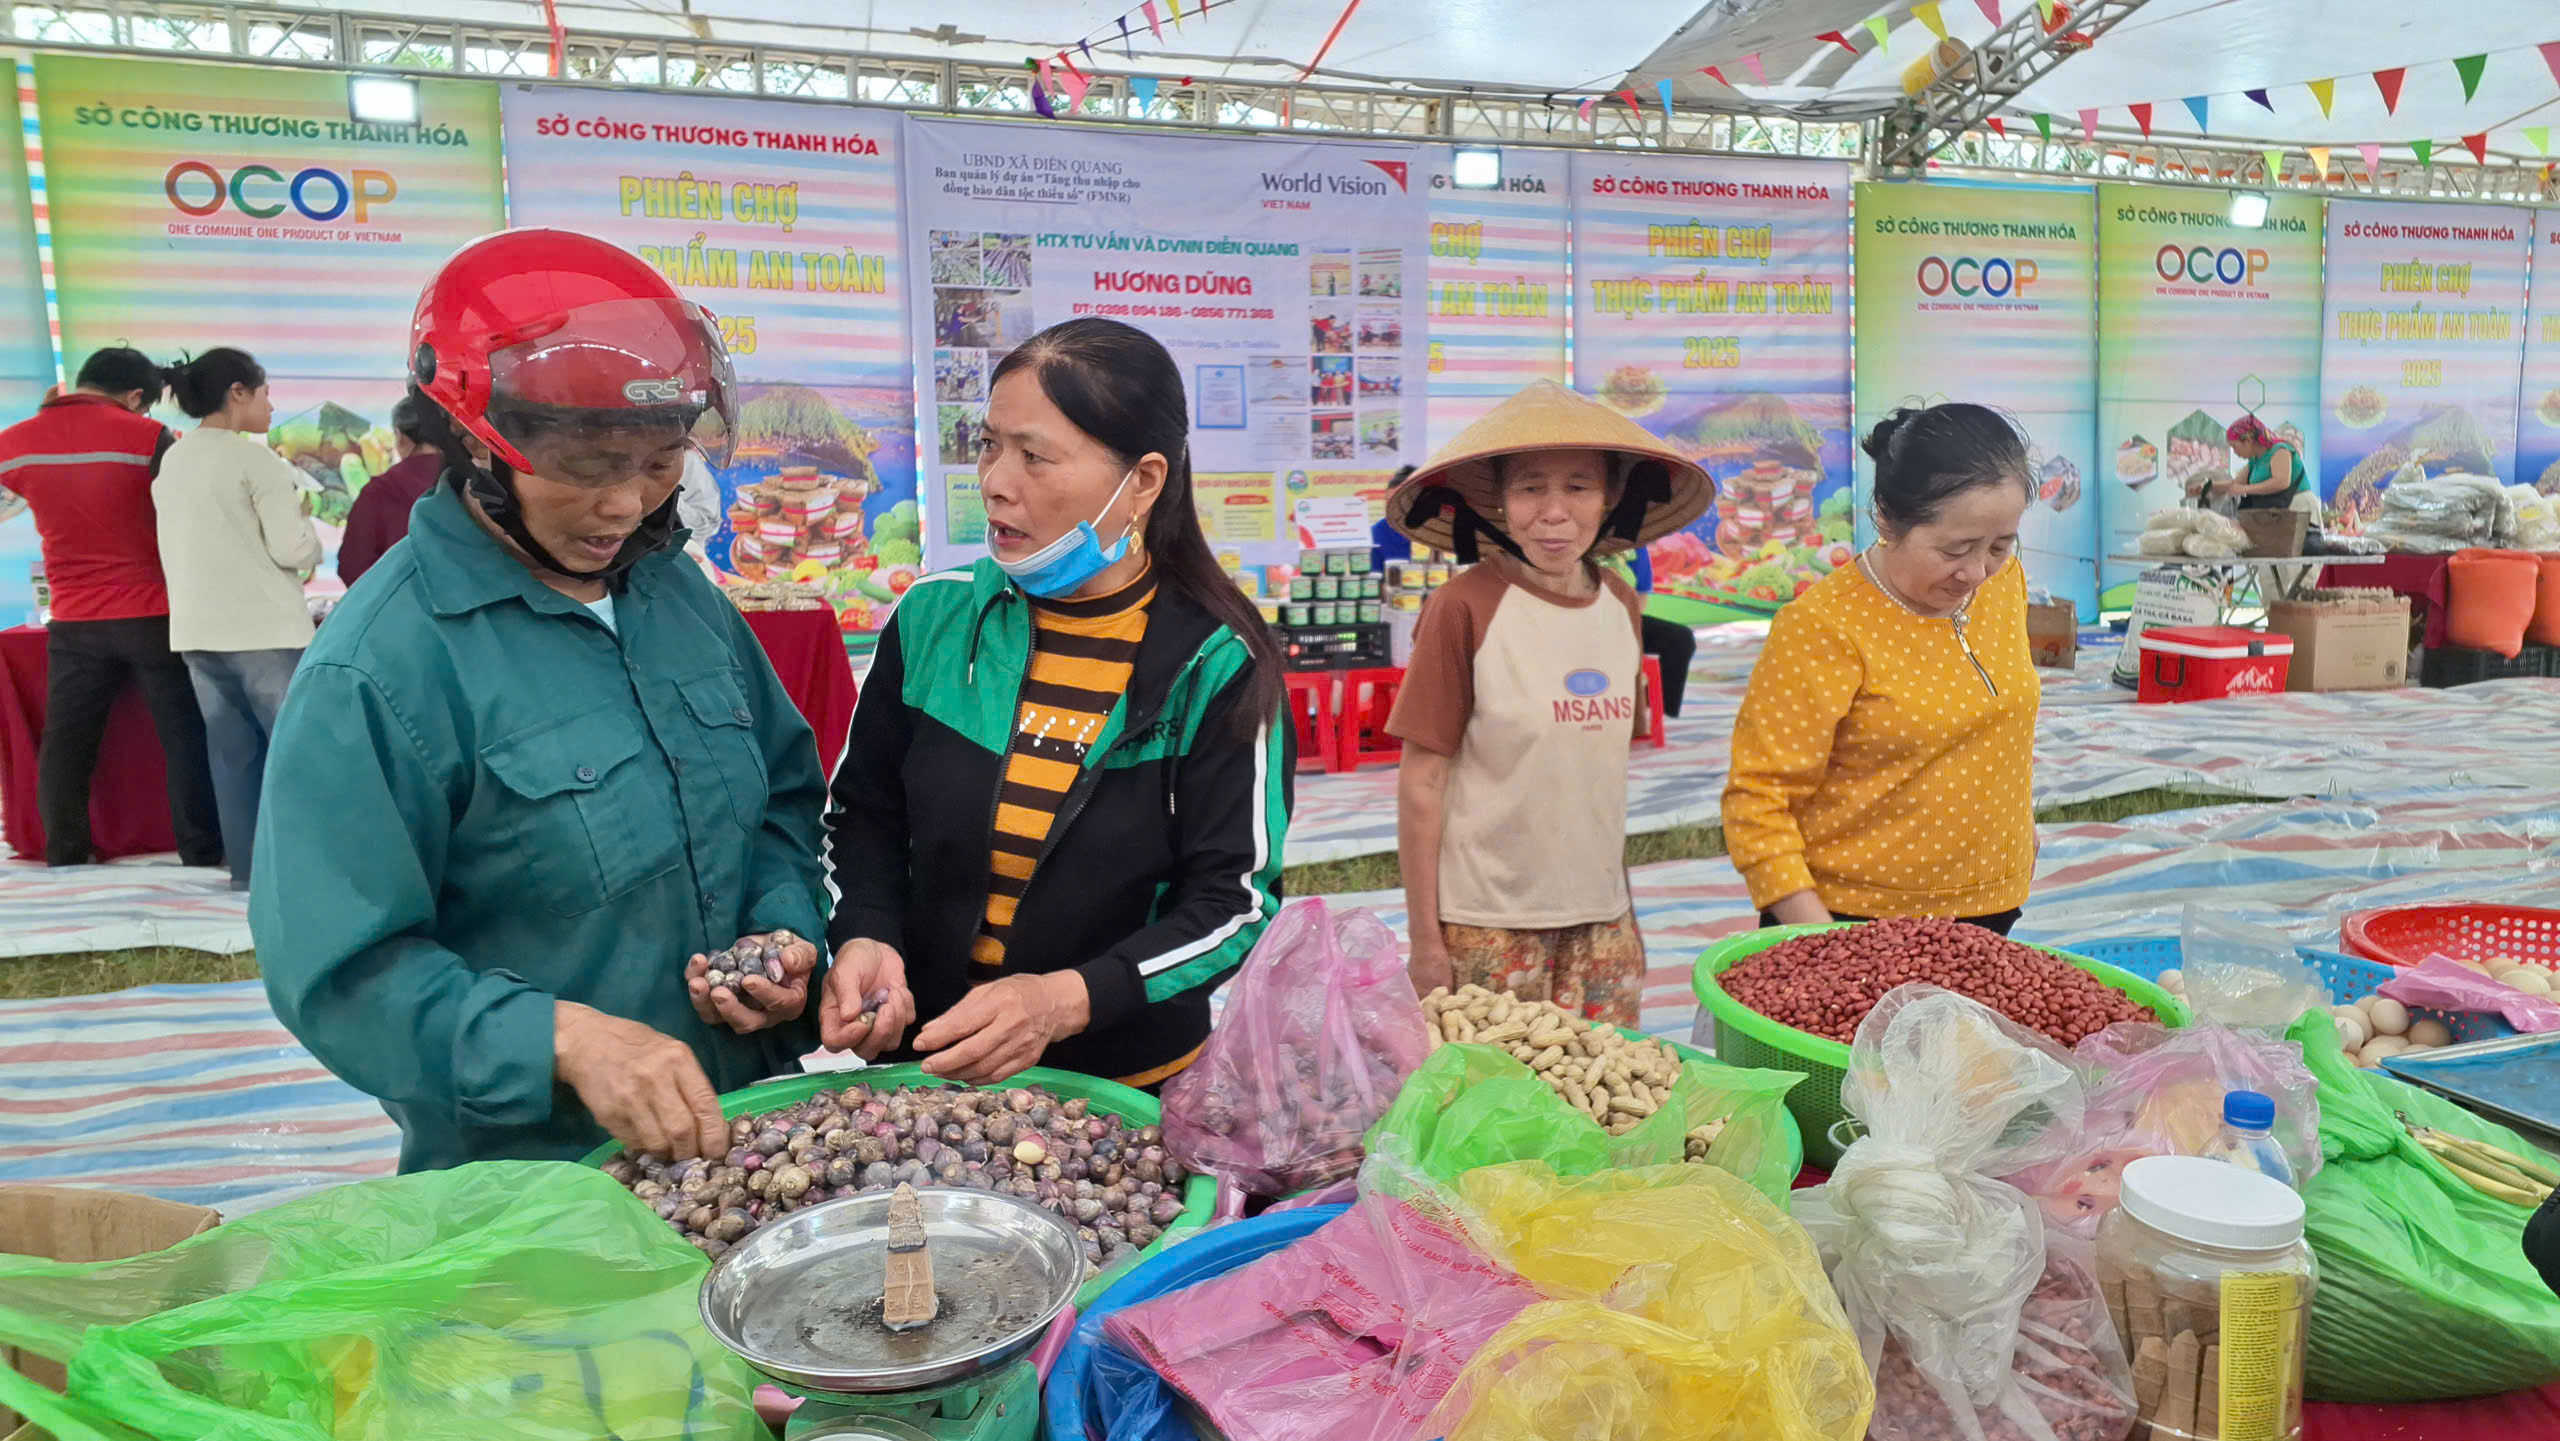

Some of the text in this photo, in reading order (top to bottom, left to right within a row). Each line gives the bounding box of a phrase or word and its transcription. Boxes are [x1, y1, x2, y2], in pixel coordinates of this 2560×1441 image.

[75, 102, 468, 146] SỞ CÔNG THƯƠNG THANH HÓA
[536, 113, 878, 156] SỞ CÔNG THƯƠNG THANH HÓA
[936, 167, 956, 178] Ban
[1074, 174, 1090, 186] thu
[1122, 178, 1140, 188] cho
[963, 153, 1004, 168] UBND
[1008, 154, 1028, 170] XÃ
[1071, 160, 1121, 175] QUANG
[165, 160, 397, 223] OCOP
[1262, 172, 1387, 195] World Vision
[1510, 175, 1546, 193] HÓA
[1592, 174, 1830, 201] SỞ CÔNG THƯƠNG THANH HÓA
[619, 171, 798, 232] PHIÊN CHỢ
[2117, 205, 2135, 221] SỞ
[2138, 207, 2177, 223] CÔNG
[168, 224, 401, 242] ONE COMMUNE ONE PRODUCT OF VIETNAM
[1875, 217, 2077, 240] SỞ CÔNG THƯƠNG THANH HÓA
[2280, 216, 2306, 232] HÓA
[2344, 221, 2515, 241] SỞ CÔNG THƯƠNG THANH HÓA
[1037, 233, 1068, 248] HTX
[1072, 234, 1093, 248] TƯ
[1133, 235, 1155, 252] VÀ
[1246, 242, 1298, 257] QUANG
[1431, 219, 1483, 266] CHỢ
[1648, 218, 1772, 266] PHIÊN CHỢ
[748, 250, 793, 289] AN
[801, 246, 884, 294] TOÀN
[1916, 255, 2040, 297] OCOP
[2155, 244, 2270, 286] OCOP
[2380, 258, 2472, 298] PHIÊN CHỢ
[1094, 270, 1252, 296] HƯƠNG DŨNG
[1440, 275, 1548, 318] AN TOÀN
[1591, 267, 1833, 320] THỰC PHẨM AN TOÀN
[719, 316, 756, 354] 25
[2441, 312, 2465, 341] AN
[2469, 307, 2511, 341] TOÀN
[1683, 335, 1740, 369] 2025
[624, 380, 680, 401] GRS
[1552, 696, 1632, 723] MSANS
